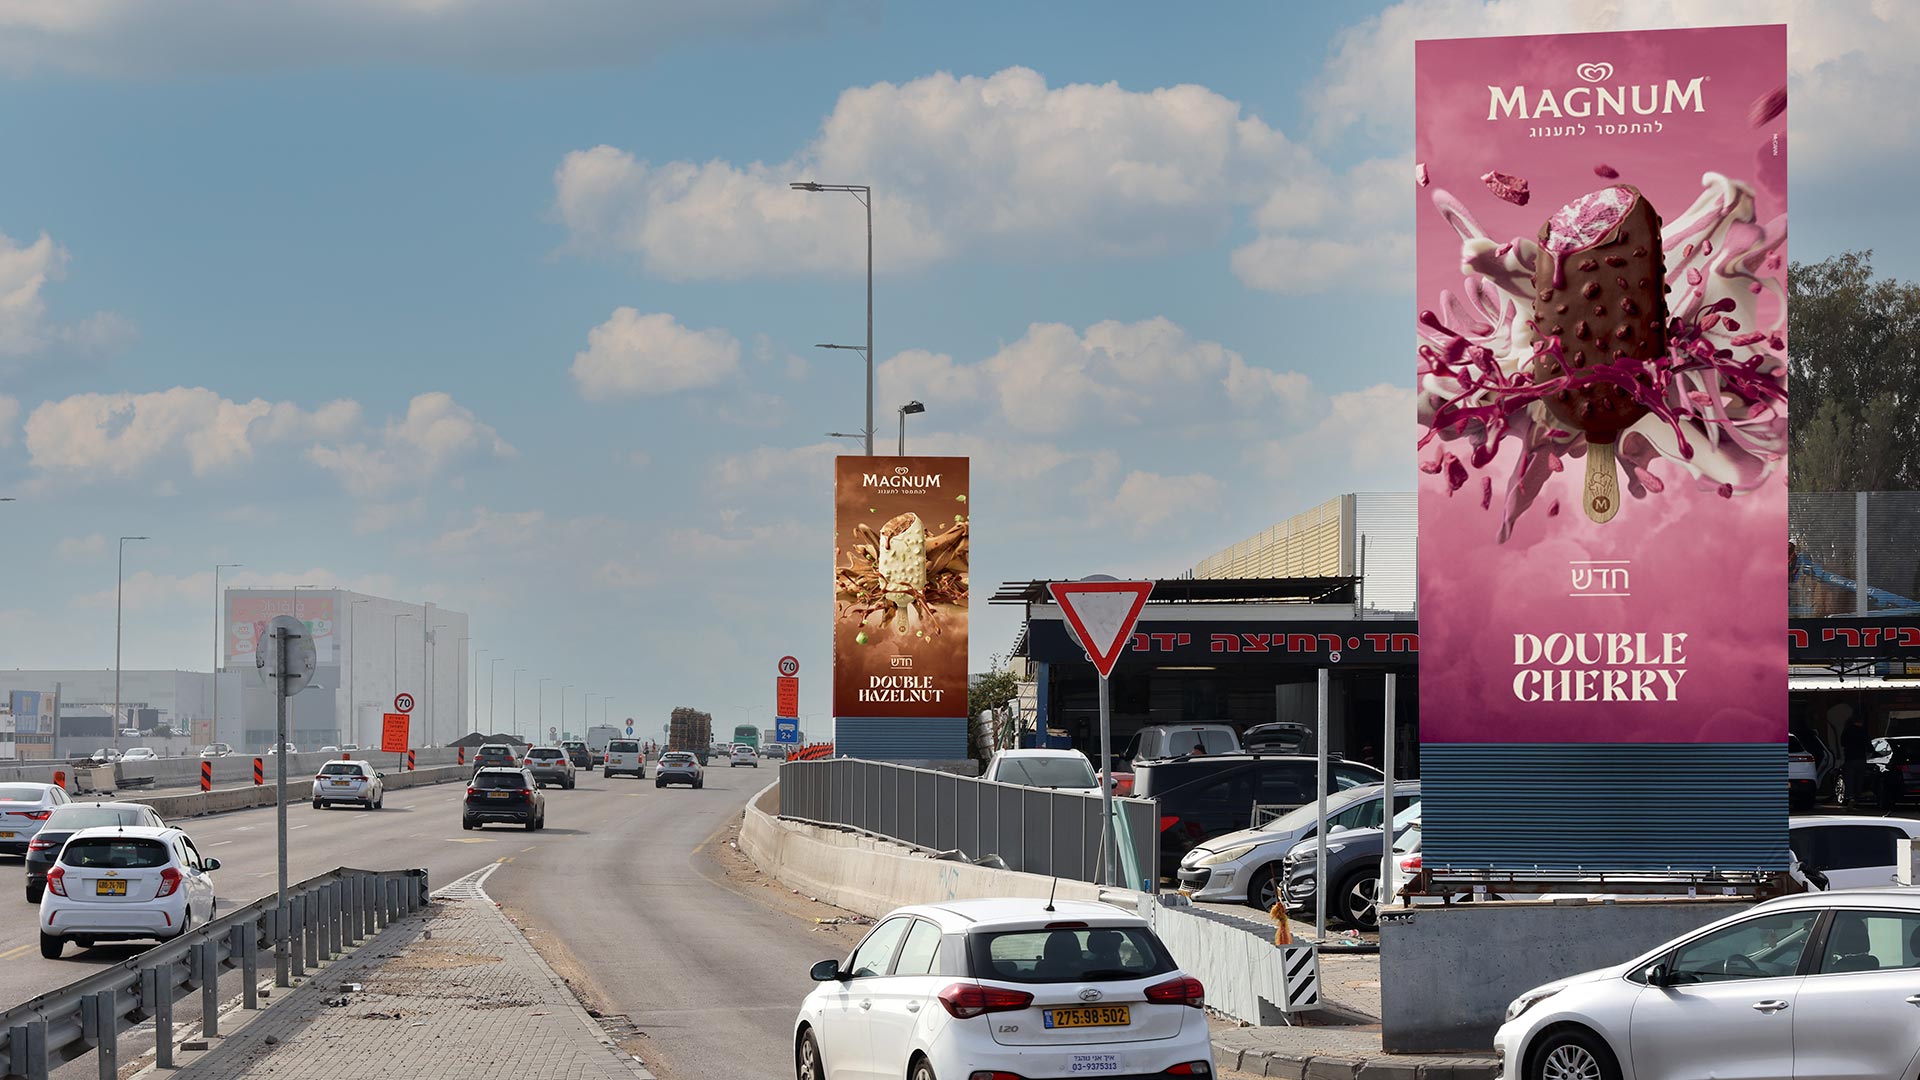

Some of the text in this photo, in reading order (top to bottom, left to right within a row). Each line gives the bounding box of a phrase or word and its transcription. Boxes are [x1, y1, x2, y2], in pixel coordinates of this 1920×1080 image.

[1487, 77, 1705, 120] MAGNUM
[1529, 121, 1663, 137] להתמסר לתענוג
[862, 473, 941, 488] MAGNUM
[1571, 568, 1630, 590] חדש
[1126, 633, 1191, 651] ידנ
[1210, 633, 1342, 652] רחיצה
[1513, 632, 1688, 665] DOUBLE
[783, 662, 796, 671] 70
[891, 657, 913, 667] חדש
[870, 676, 933, 688] DOUBLE
[1513, 669, 1688, 702] CHERRY
[399, 698, 411, 708] 70
[859, 689, 944, 702] HAZELNUT
[1072, 1062, 1117, 1071] 03-9375313
